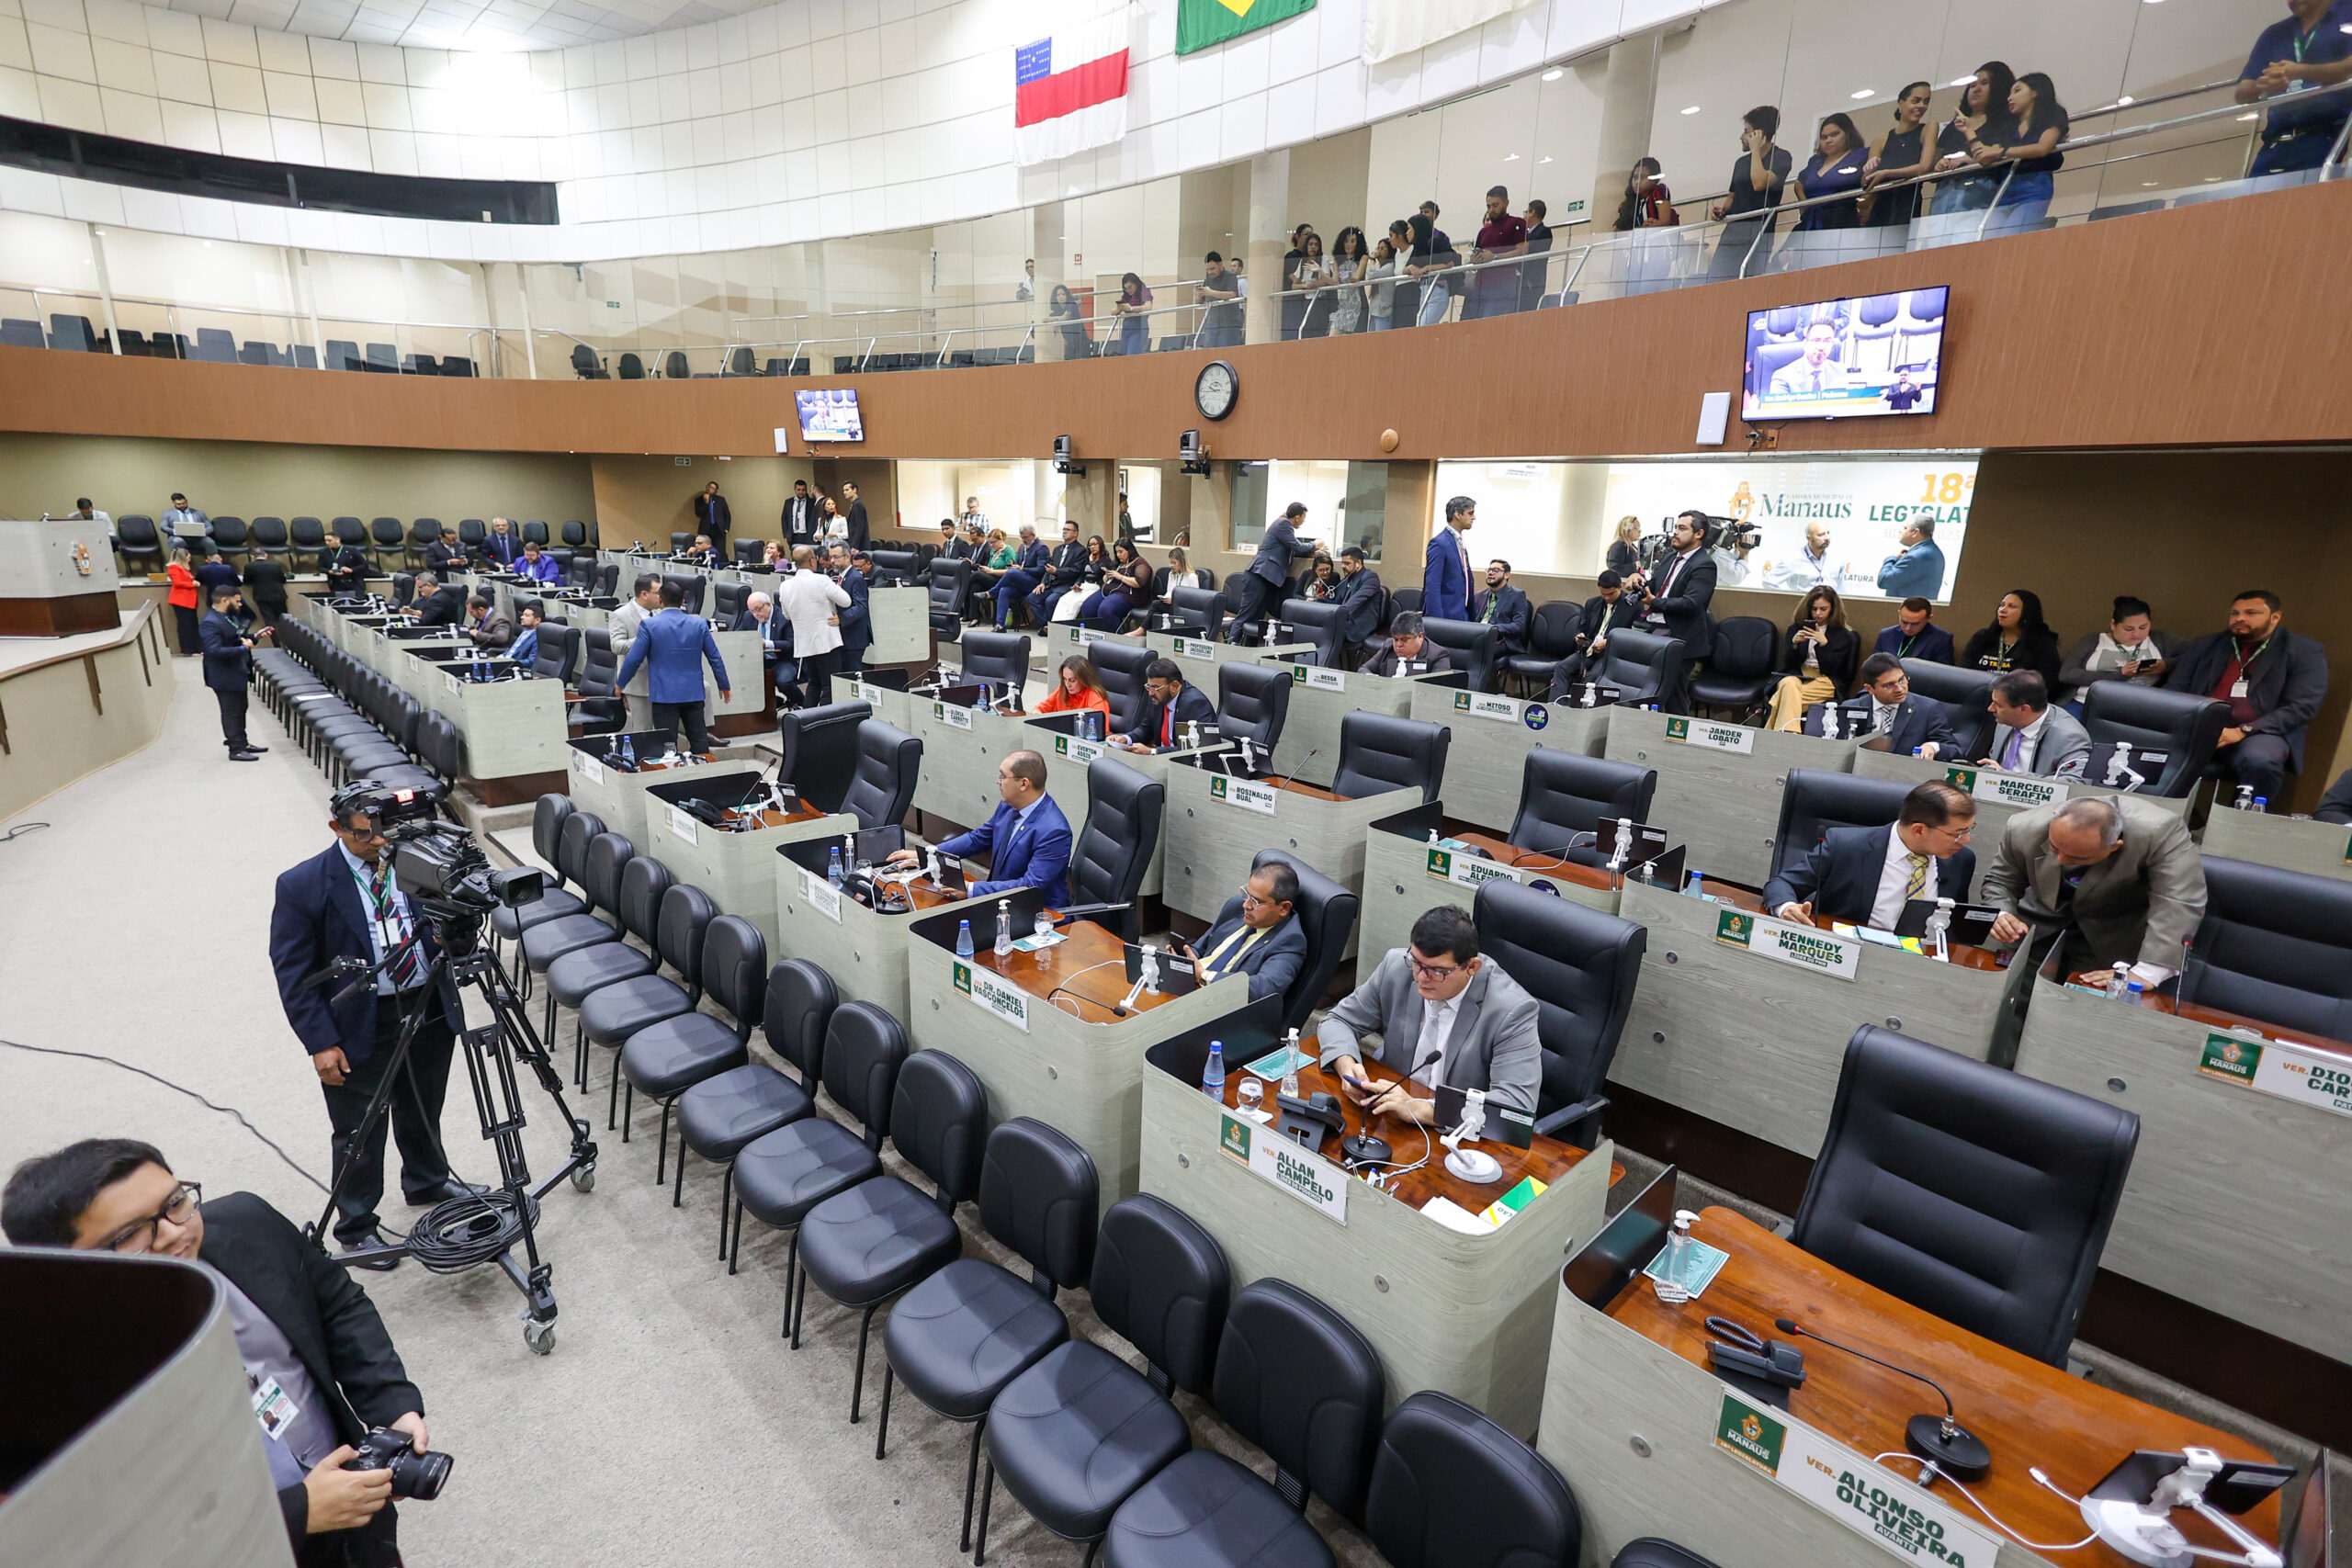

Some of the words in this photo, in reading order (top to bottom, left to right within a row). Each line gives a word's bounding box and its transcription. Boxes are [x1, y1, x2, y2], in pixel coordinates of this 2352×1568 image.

[1758, 493, 1851, 519] Manaus
[1486, 702, 1510, 711] MITOSO
[1708, 734, 1740, 744] LOBATO
[1709, 727, 1743, 739] JANDER
[1236, 786, 1272, 802] ROSINALDO
[1236, 794, 1252, 803] BUAL
[1998, 787, 2051, 801] SERAFIM
[1999, 779, 2054, 795] MARCELO
[1778, 939, 1843, 964] MARQUES
[1780, 930, 1843, 953] KENNEDY
[974, 985, 1024, 1019] VASCONCELOS
[996, 987, 1023, 1010] DANIEL
[2209, 1058, 2247, 1075] MANAUS
[2282, 1062, 2309, 1075] VER.
[2310, 1066, 2352, 1086] DIO
[2307, 1077, 2352, 1098] CAR
[1262, 1146, 1277, 1159] VER.
[1277, 1151, 1315, 1179] ALLAN
[1276, 1162, 1333, 1201] CAMPELO
[1727, 1430, 1770, 1460] MANAUS
[1731, 1447, 1772, 1474] LEGISLATURA
[1806, 1455, 1837, 1480] VER.
[1838, 1470, 1945, 1540] ALONSO
[1836, 1488, 1966, 1568] OLIVEIRA
[1876, 1525, 1917, 1553] AVANTE
